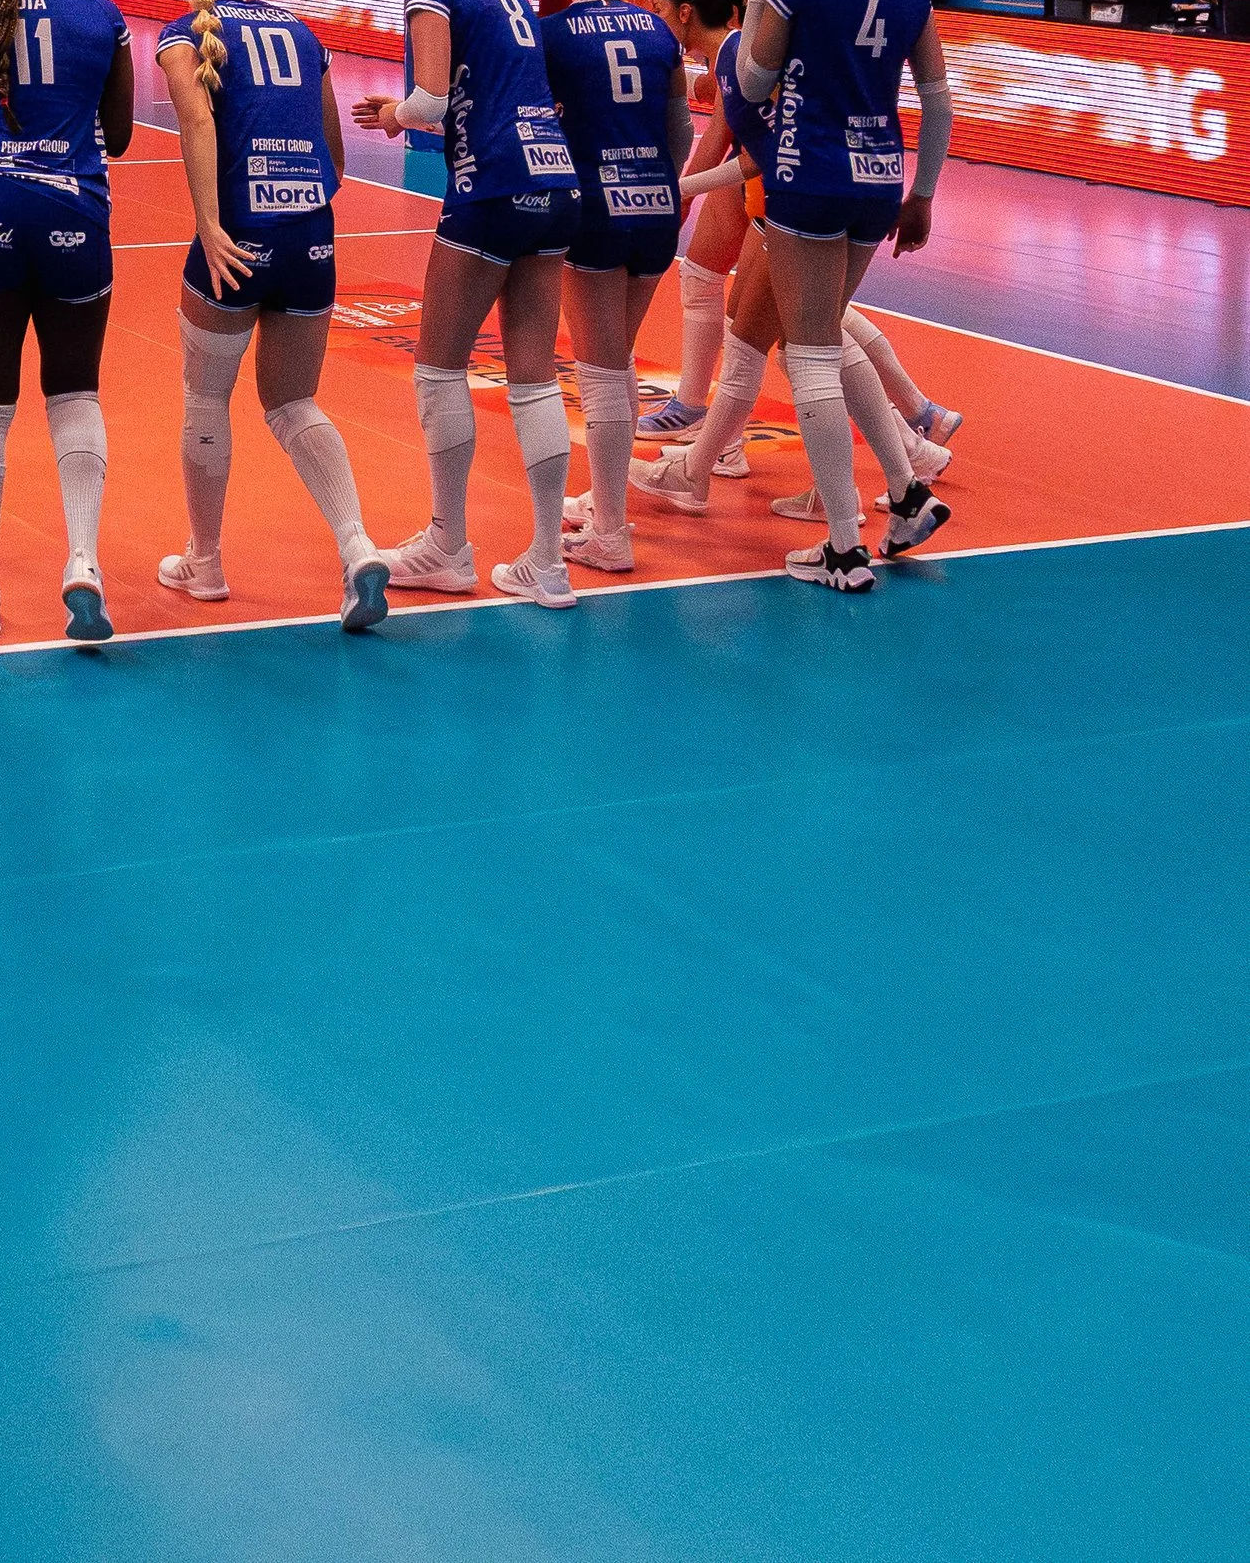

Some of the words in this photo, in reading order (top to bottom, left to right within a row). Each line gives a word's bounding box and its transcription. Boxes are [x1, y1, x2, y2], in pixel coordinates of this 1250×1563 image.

[566, 16, 597, 35] VAN
[598, 14, 616, 33] DE
[614, 13, 656, 33] VYVER
[15, 17, 54, 85] 11
[241, 25, 302, 87] 10
[604, 40, 643, 103] 6
[1, 140, 37, 153] PERFECT
[39, 139, 70, 154] GROUP
[252, 138, 285, 152] PERFECT
[287, 139, 314, 153] GROUP
[602, 147, 635, 161] PERFECT
[527, 147, 571, 167] Nord
[854, 154, 902, 176] Nord
[269, 166, 319, 174] Hauts-de-France
[255, 184, 321, 205] Nord
[610, 187, 670, 208] Nord
[49, 230, 86, 247] GGP
